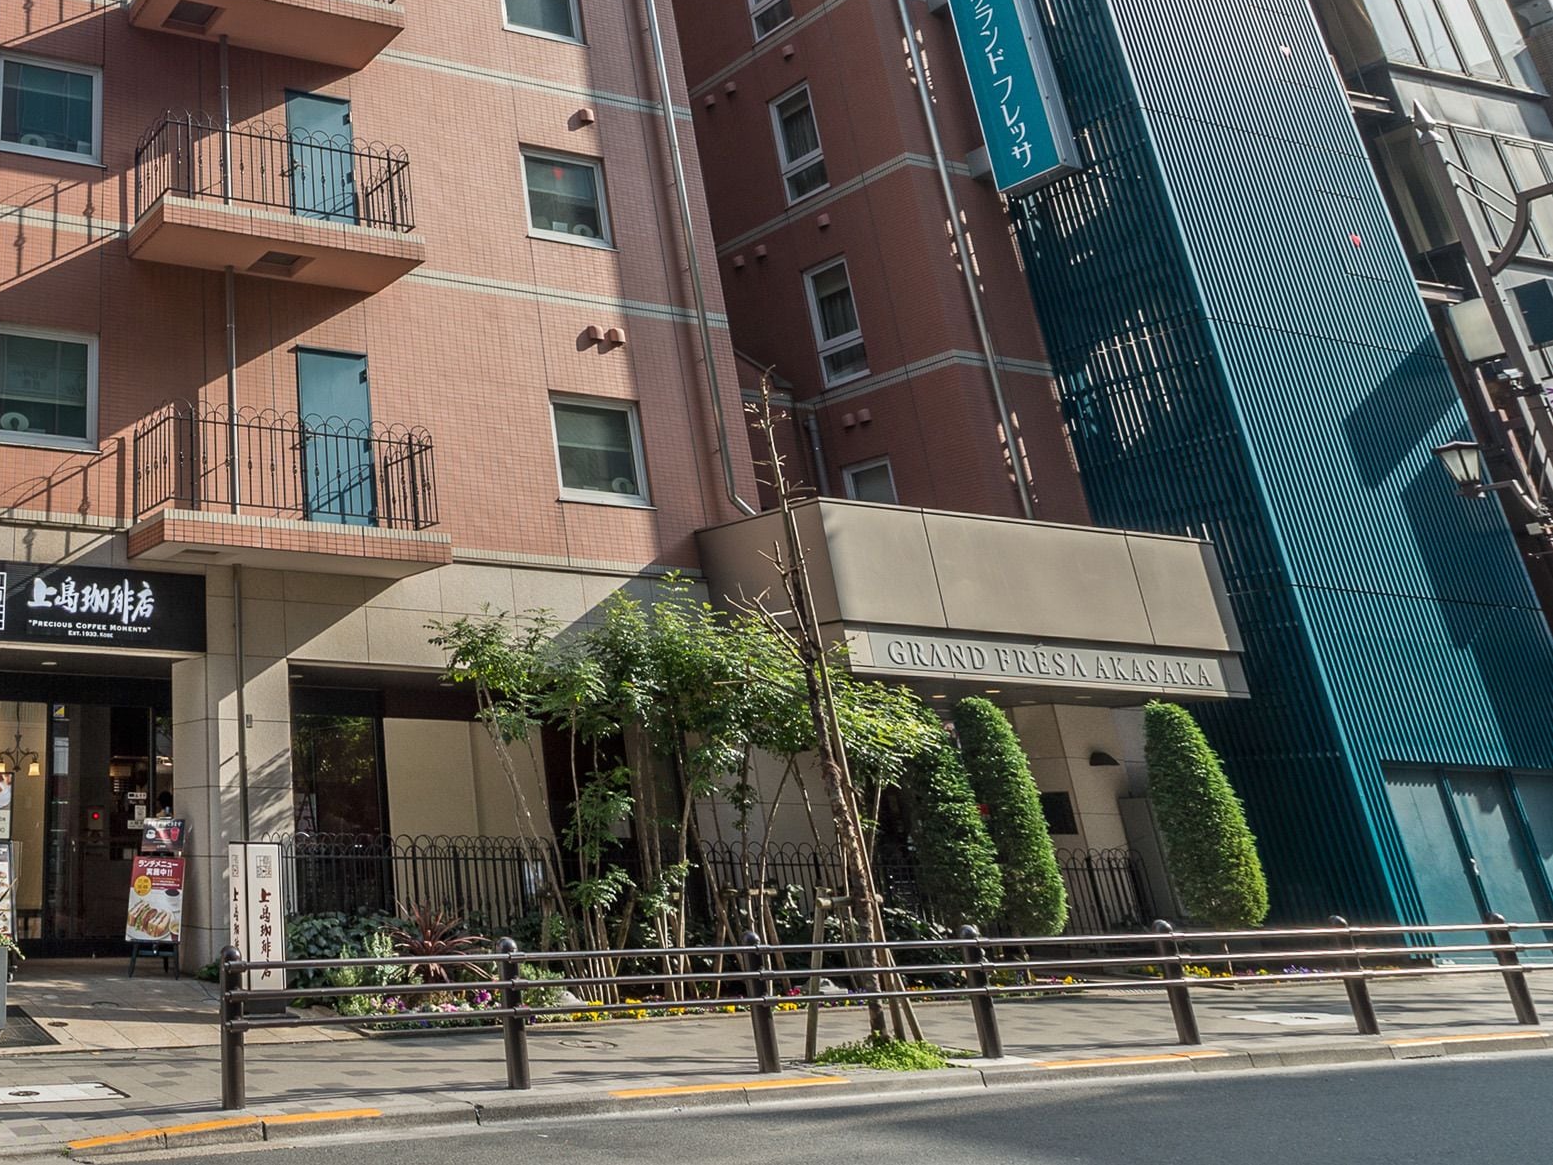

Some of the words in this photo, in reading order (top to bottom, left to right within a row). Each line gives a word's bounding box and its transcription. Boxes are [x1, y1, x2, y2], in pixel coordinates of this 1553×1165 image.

[27, 576, 155, 624] 上島珈琲店
[887, 639, 990, 670] GRAND
[1095, 654, 1214, 688] AKASAKA
